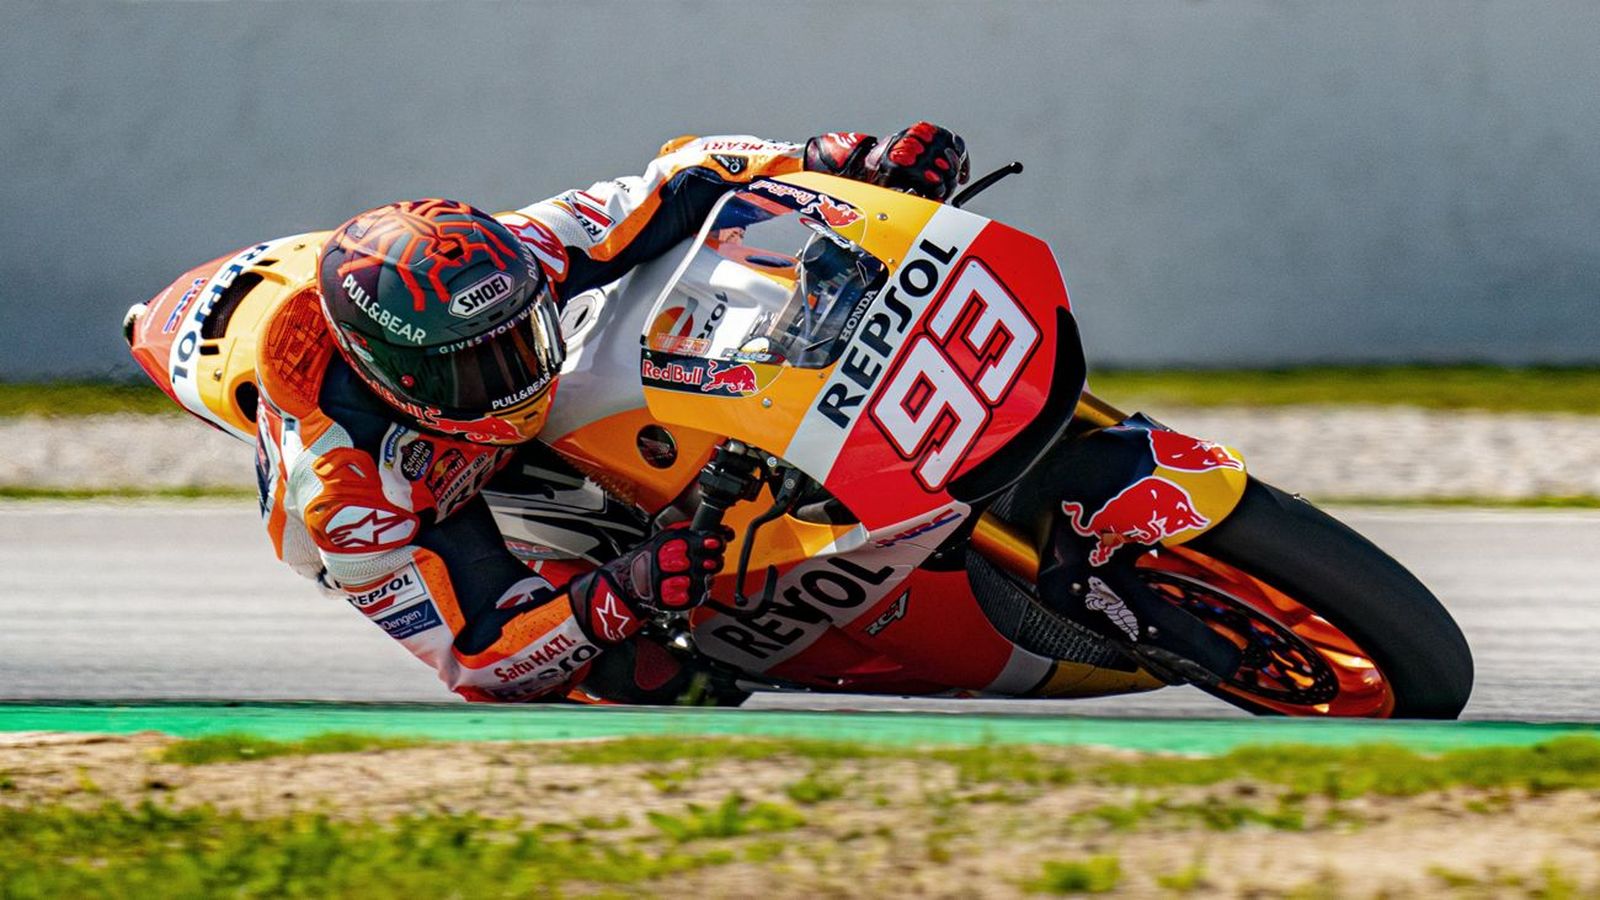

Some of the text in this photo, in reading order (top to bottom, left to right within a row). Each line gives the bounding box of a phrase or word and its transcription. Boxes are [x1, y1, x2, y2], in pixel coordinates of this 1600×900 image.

[342, 274, 426, 345] PULL&BEAR
[458, 276, 508, 313] SHOEI
[817, 239, 958, 429] REPSOL
[839, 289, 878, 343] HONDA
[439, 336, 483, 353] GIVES
[487, 319, 516, 340] YOU
[491, 372, 551, 410] PULL&BEAR
[869, 256, 1043, 492] 93
[402, 441, 426, 472] Estrella
[410, 448, 431, 477] Galicia
[381, 610, 422, 630] Dengen
[493, 633, 577, 684] Satu HATI.
